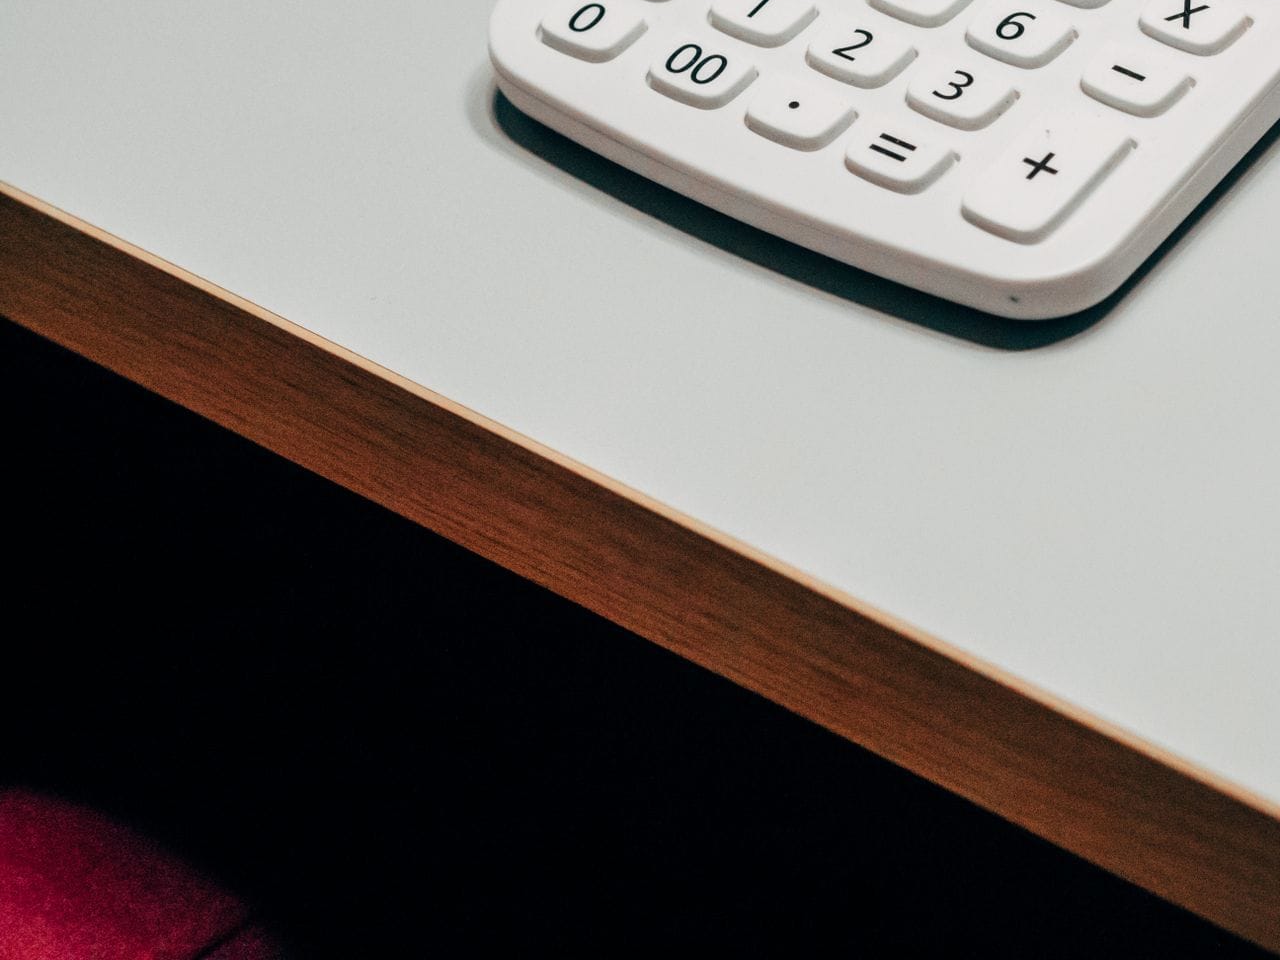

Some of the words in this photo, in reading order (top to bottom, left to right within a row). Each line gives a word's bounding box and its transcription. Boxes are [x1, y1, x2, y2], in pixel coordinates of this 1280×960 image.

[567, 2, 606, 33] 0
[995, 11, 1037, 41] 6
[831, 28, 874, 62] 2
[664, 42, 729, 85] 00
[931, 69, 975, 101] 3
